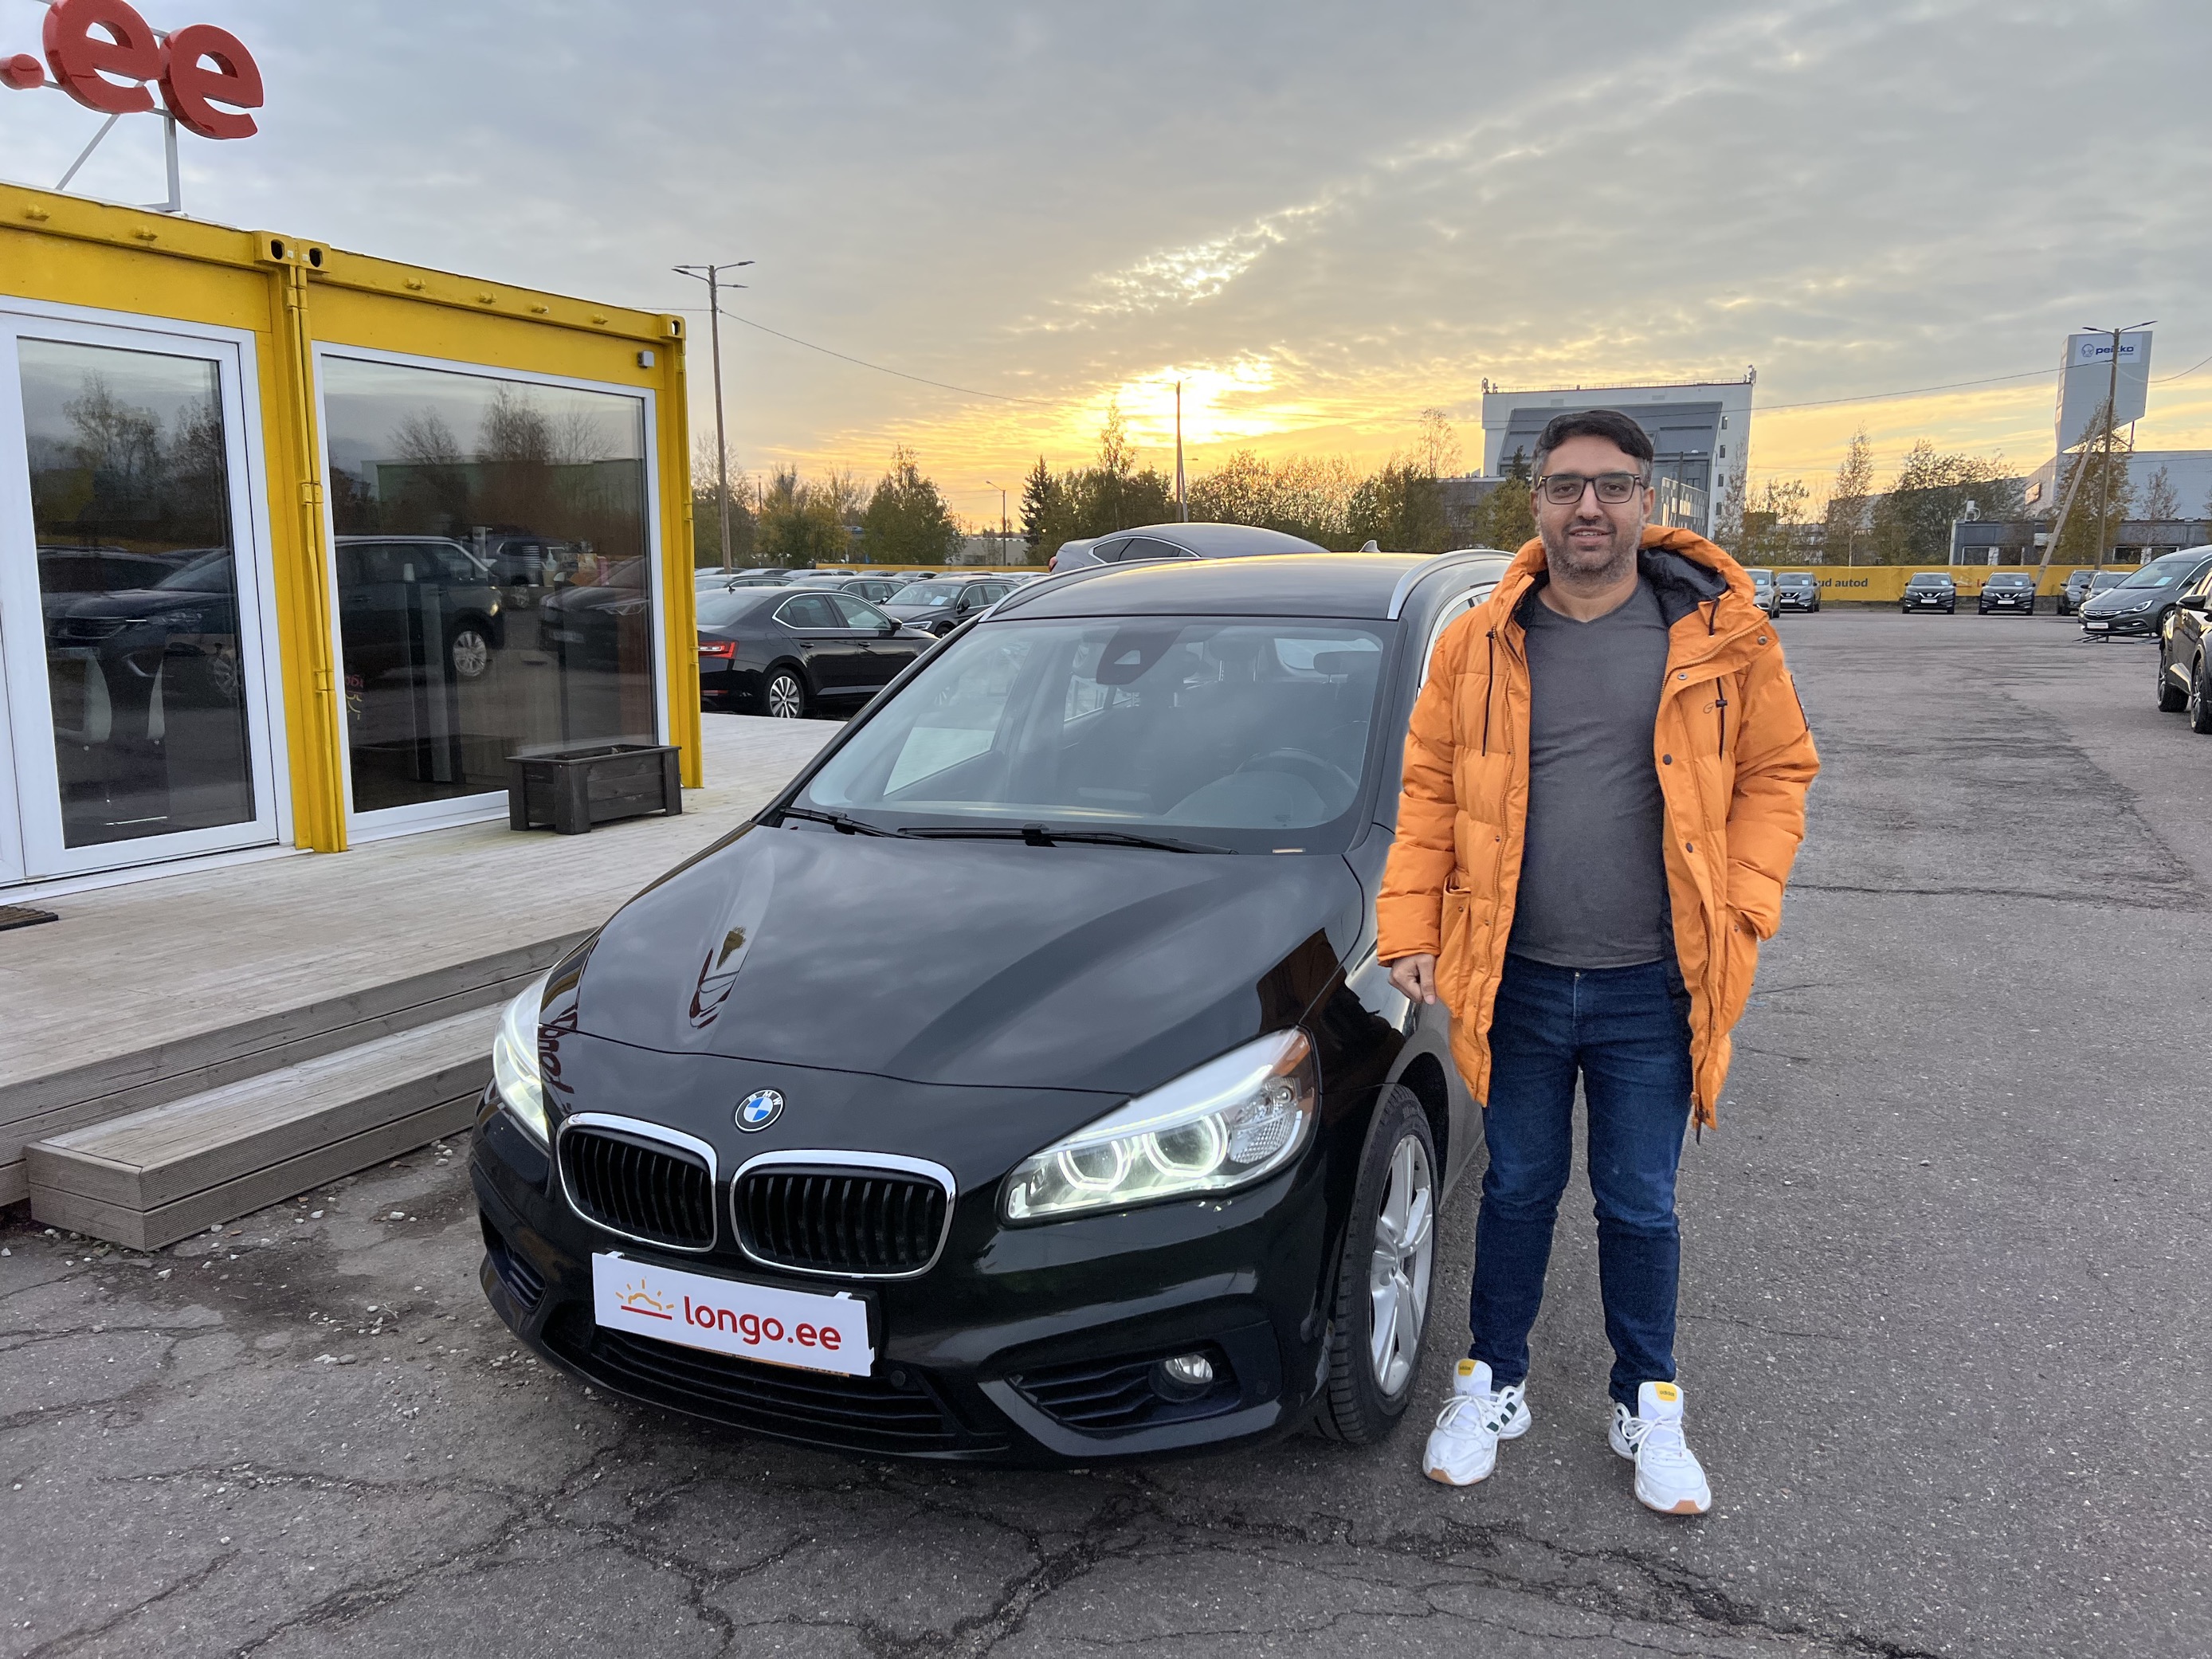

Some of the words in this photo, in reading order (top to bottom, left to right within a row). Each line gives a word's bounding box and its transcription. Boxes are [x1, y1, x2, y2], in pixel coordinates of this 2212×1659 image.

[2096, 345, 2134, 355] peiko
[1835, 578, 1868, 587] autod
[684, 1295, 841, 1350] longo.ee
